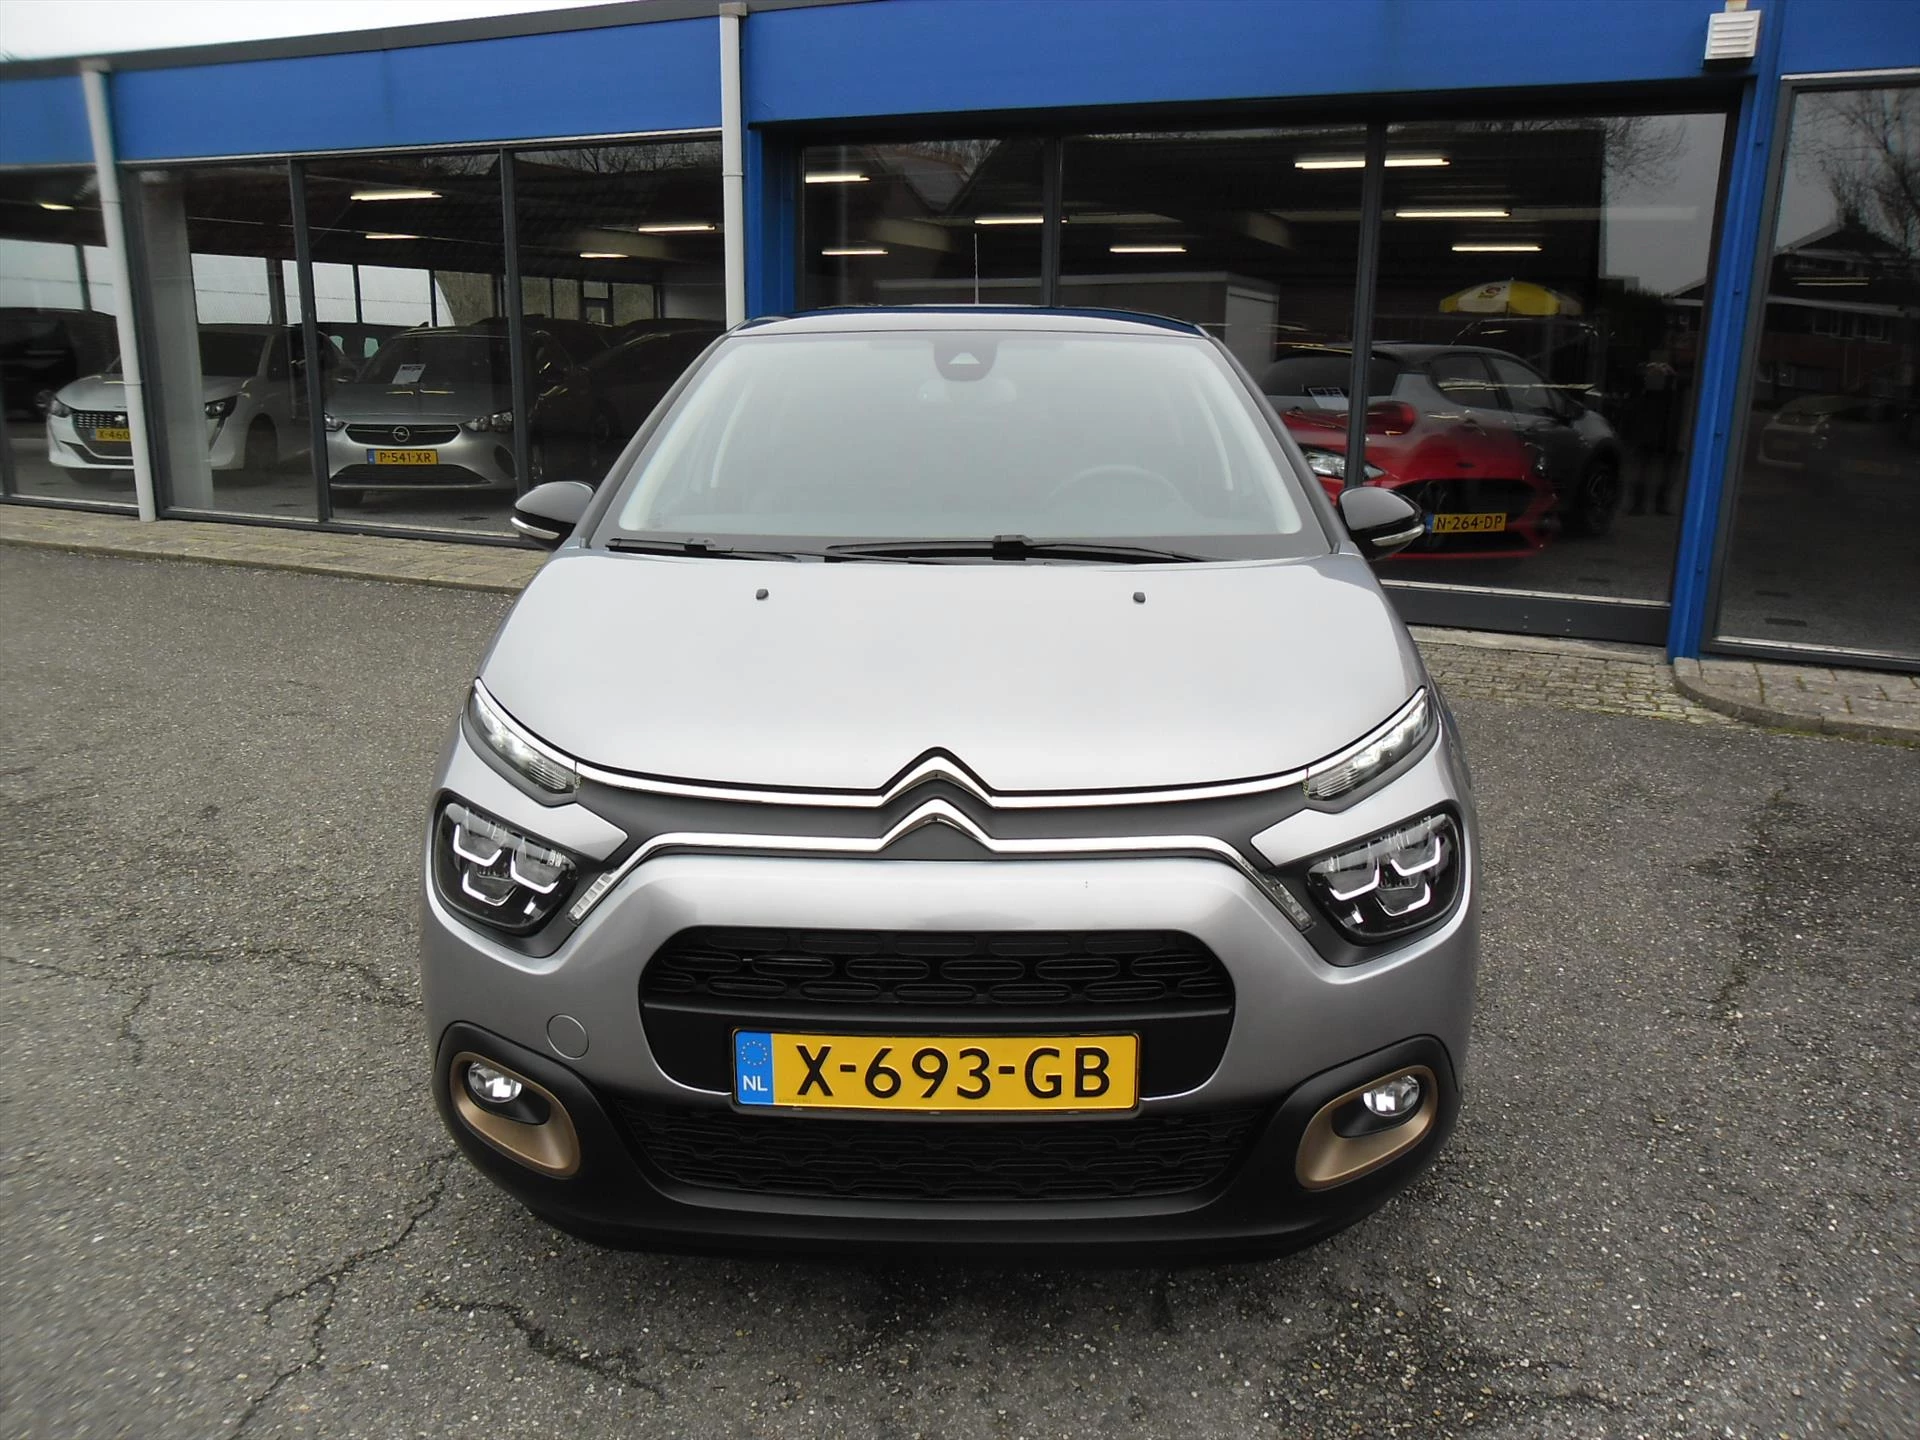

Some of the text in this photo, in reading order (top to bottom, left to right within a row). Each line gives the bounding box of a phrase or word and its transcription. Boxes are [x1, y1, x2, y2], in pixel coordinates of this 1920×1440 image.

[379, 452, 432, 463] P-541-XR
[1436, 515, 1503, 530] N-264-DP
[796, 1045, 1110, 1100] X-693-GB
[743, 1075, 768, 1092] NL
